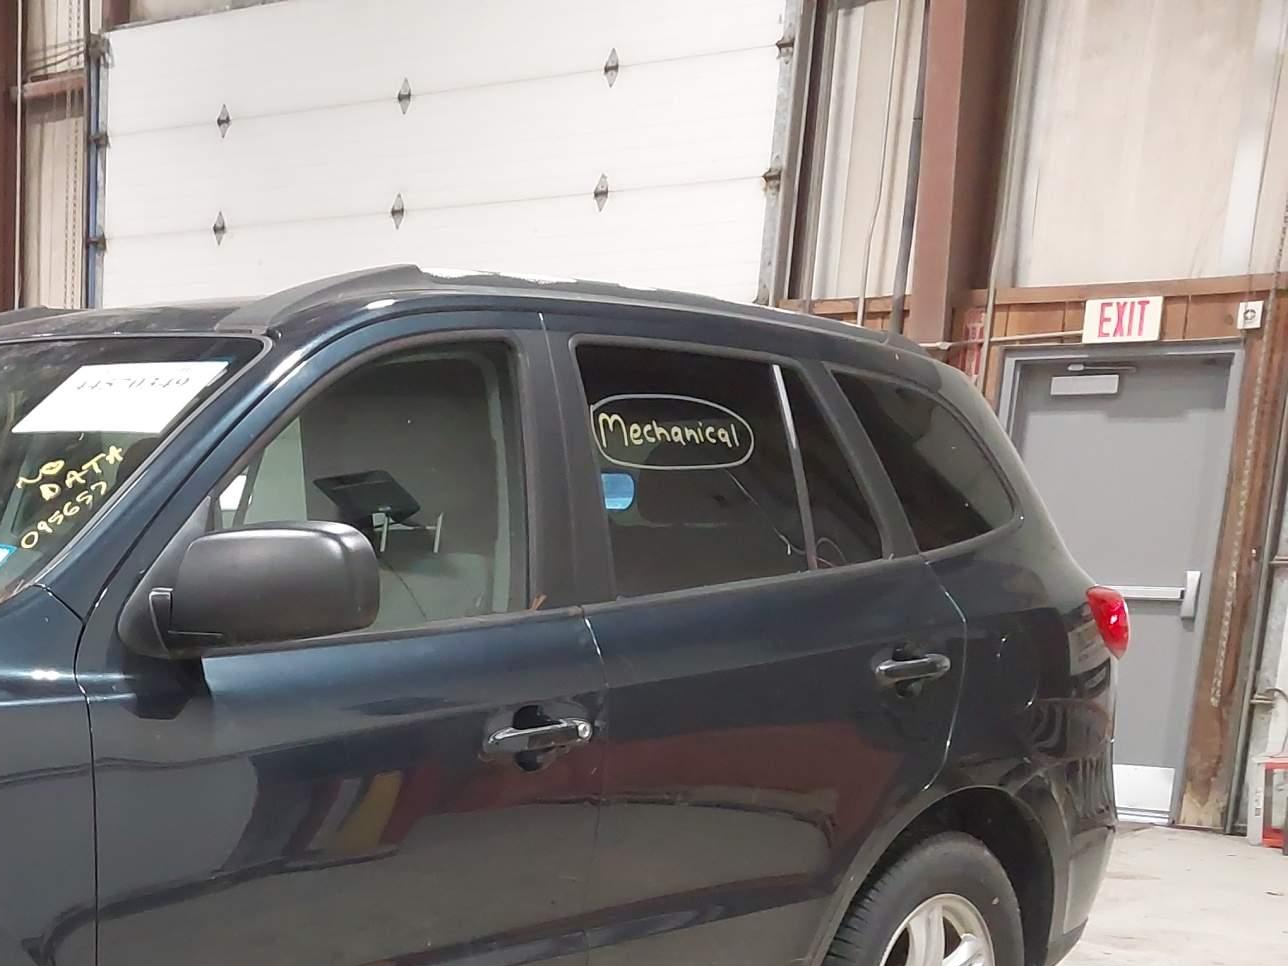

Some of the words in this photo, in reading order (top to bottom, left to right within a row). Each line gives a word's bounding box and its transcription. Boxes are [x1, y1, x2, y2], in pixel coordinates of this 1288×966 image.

[1097, 300, 1151, 339] EXIT
[598, 412, 741, 448] Mechanical
[20, 481, 107, 549] 095657
